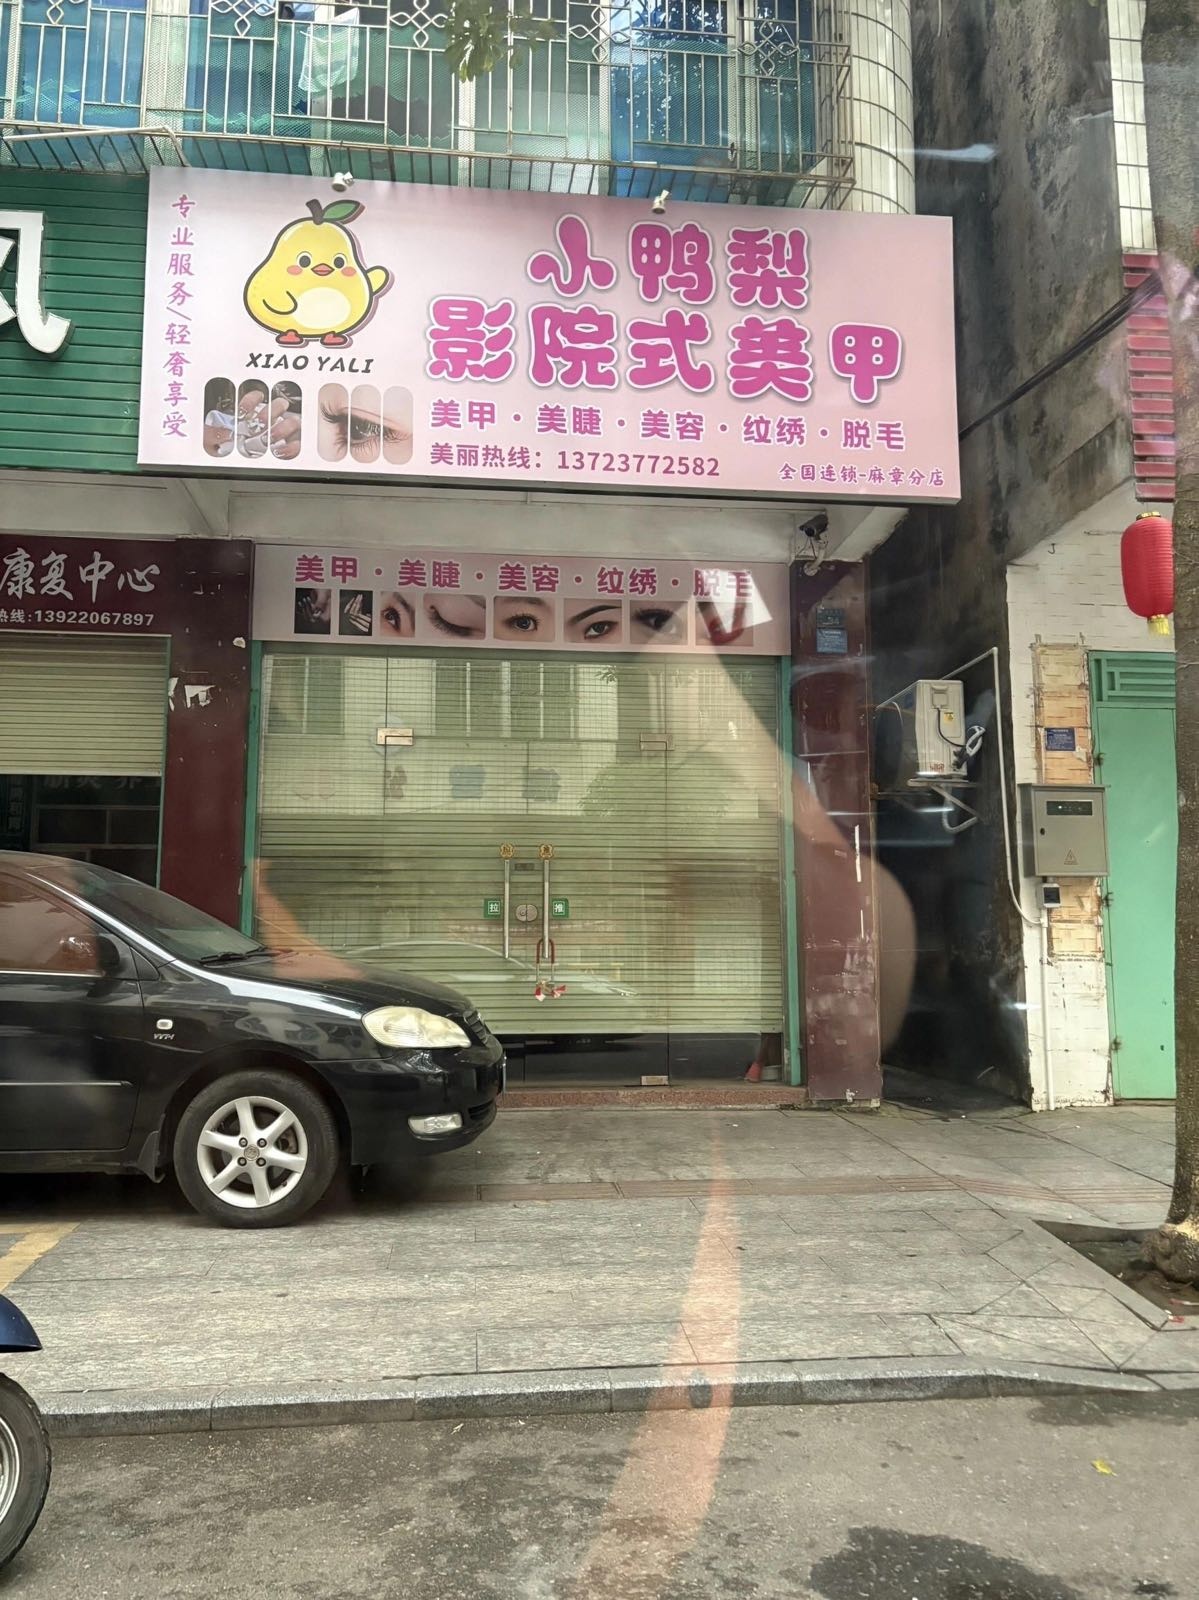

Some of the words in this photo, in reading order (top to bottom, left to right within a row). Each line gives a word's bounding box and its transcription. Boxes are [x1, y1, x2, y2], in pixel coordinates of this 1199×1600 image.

[528, 214, 809, 309] 小鸭梨
[245, 352, 309, 370] XIAO
[317, 356, 374, 373] YALI
[426, 296, 902, 404] 影院式美甲
[0, 547, 161, 604] 康复中心
